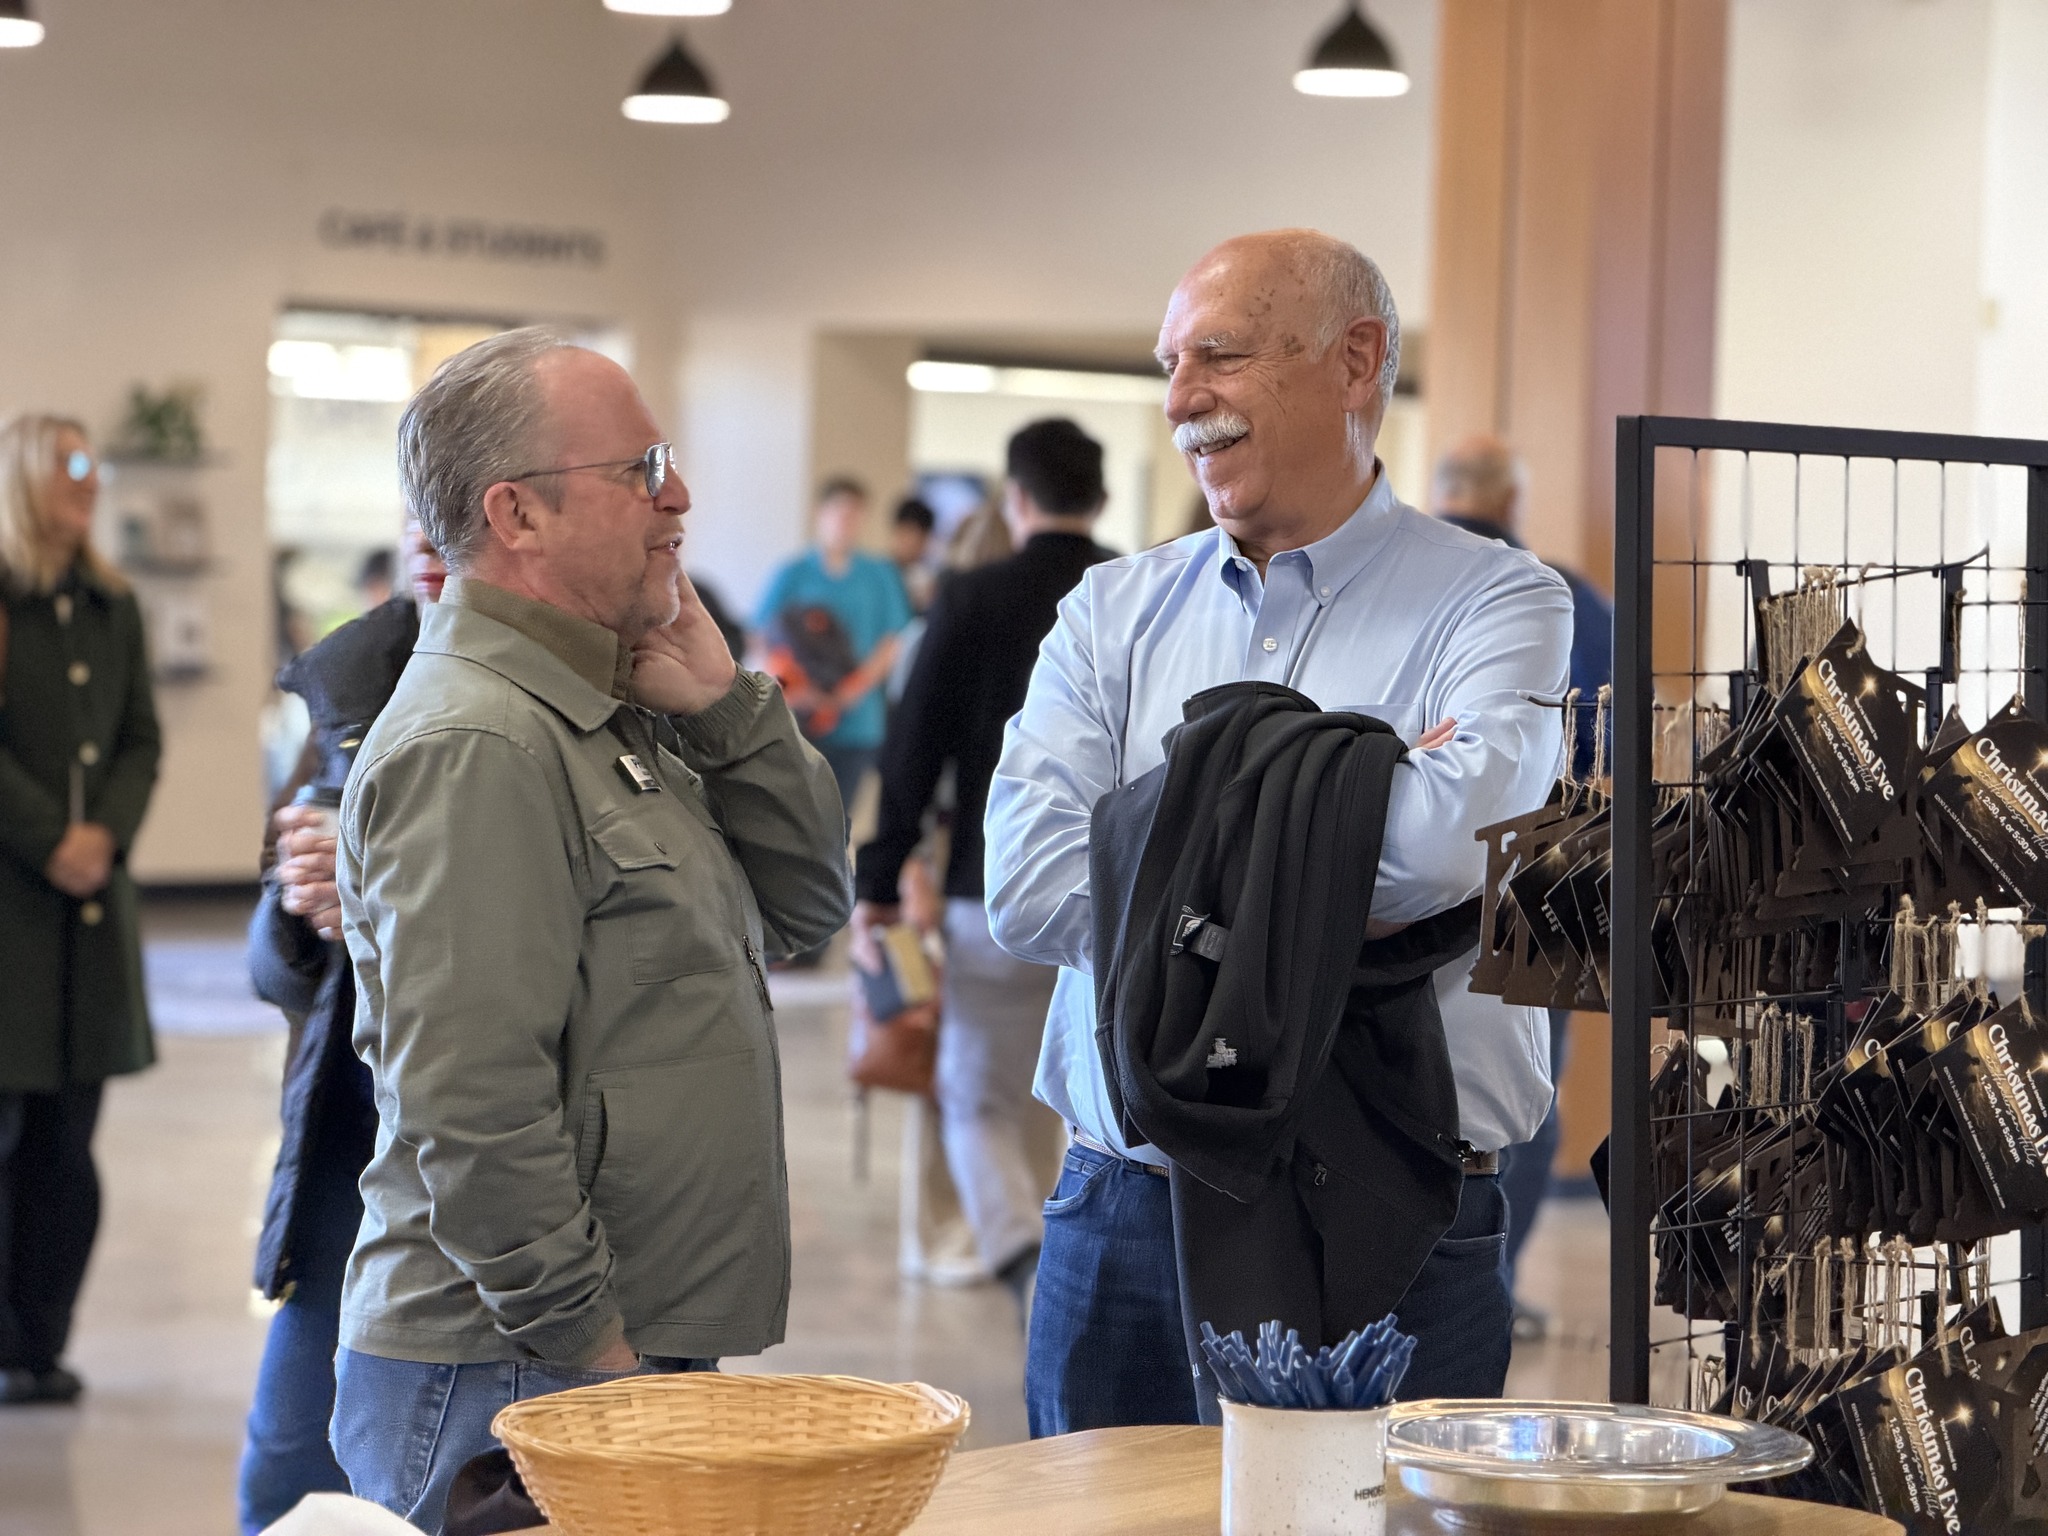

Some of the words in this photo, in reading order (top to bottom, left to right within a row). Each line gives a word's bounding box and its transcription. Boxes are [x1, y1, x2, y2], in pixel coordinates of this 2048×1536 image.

[1818, 659, 1875, 764] Christmas
[1870, 757, 1894, 801] Eve
[1817, 713, 1823, 724] 1,
[1821, 721, 1834, 744] 2:30,
[1832, 743, 1840, 754] 4,
[1837, 753, 1844, 763] or
[1841, 762, 1854, 782] 5:30
[1848, 780, 1860, 793] pm
[1855, 763, 1873, 793] Hills
[1985, 781, 2032, 833] Henderson
[1976, 789, 1983, 799] 1,
[1982, 796, 1999, 818] 2:30,
[1999, 815, 2007, 828] 4,
[2006, 824, 2014, 836] or
[2012, 830, 2029, 850] 5:30
[2024, 847, 2038, 862] pm
[1980, 1074, 1987, 1084] 1,
[1988, 1024, 2042, 1138] Christmas
[1984, 1082, 1998, 1107] 2:30,
[1994, 1107, 2003, 1119] 4,
[1998, 1117, 2007, 1129] or
[2002, 1128, 2017, 1148] 5:30
[2009, 1148, 2021, 1163] pm
[2018, 1135, 2035, 1167] Hills
[1889, 1417, 1897, 1427] 1,
[1891, 1427, 1905, 1453] 2:30,
[1905, 1368, 1949, 1493] Christmas
[1938, 1489, 1961, 1535] Eve
[1899, 1453, 1906, 1464] 4,
[1902, 1465, 1910, 1477] or
[1905, 1476, 1918, 1497] 5:30
[1910, 1497, 1921, 1513] pm
[1921, 1484, 1941, 1519] Hills
